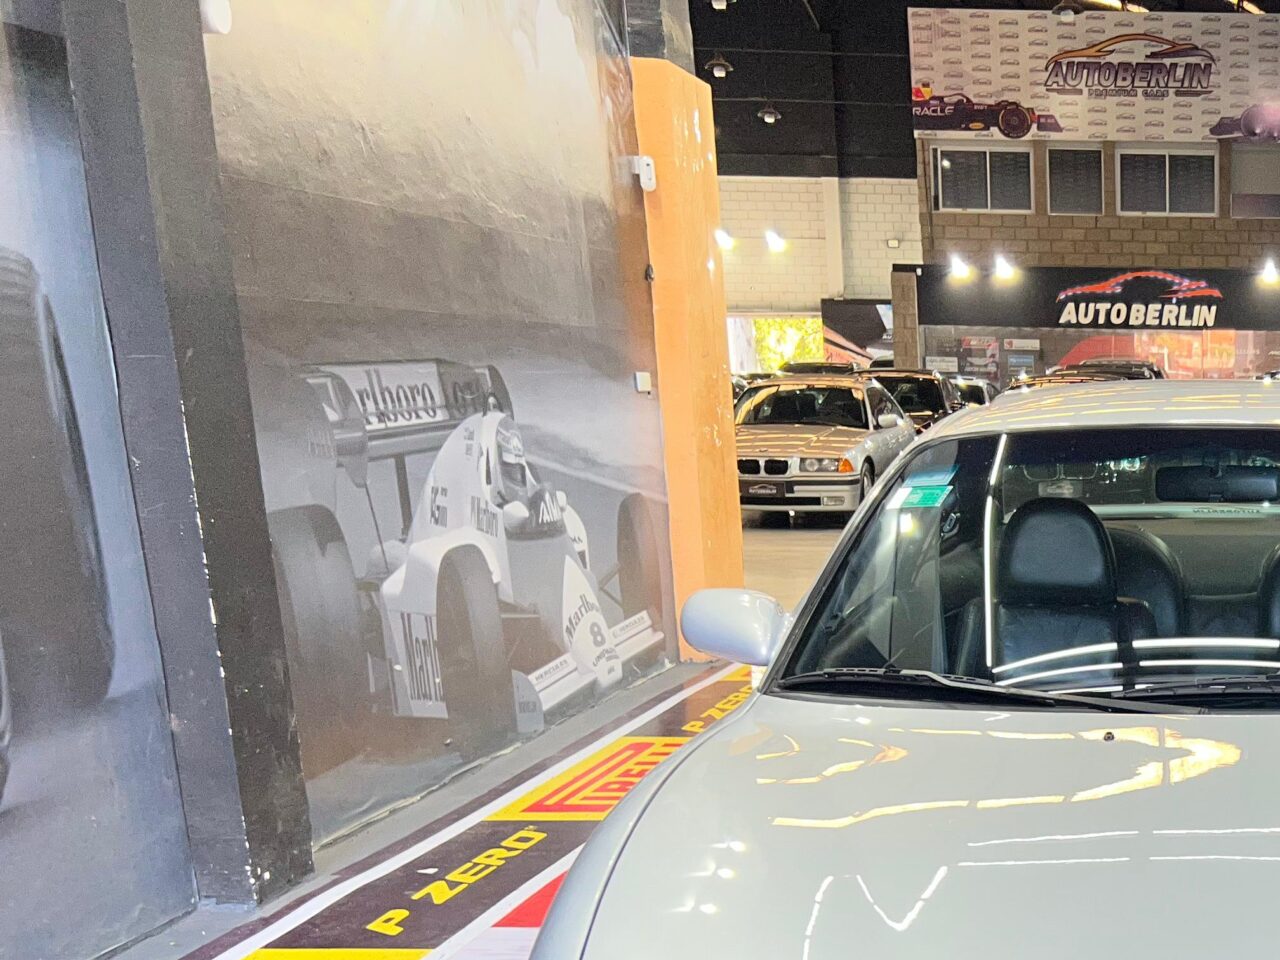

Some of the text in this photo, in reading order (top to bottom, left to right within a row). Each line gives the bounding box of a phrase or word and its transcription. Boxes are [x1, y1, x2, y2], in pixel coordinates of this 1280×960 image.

[1044, 61, 1212, 89] AUTOBERLIN
[1088, 89, 1169, 98] PREMIUM CARS
[355, 367, 438, 426] rlboro
[590, 622, 606, 648] 8
[681, 720, 705, 734] P
[365, 830, 549, 937] P ZERO
